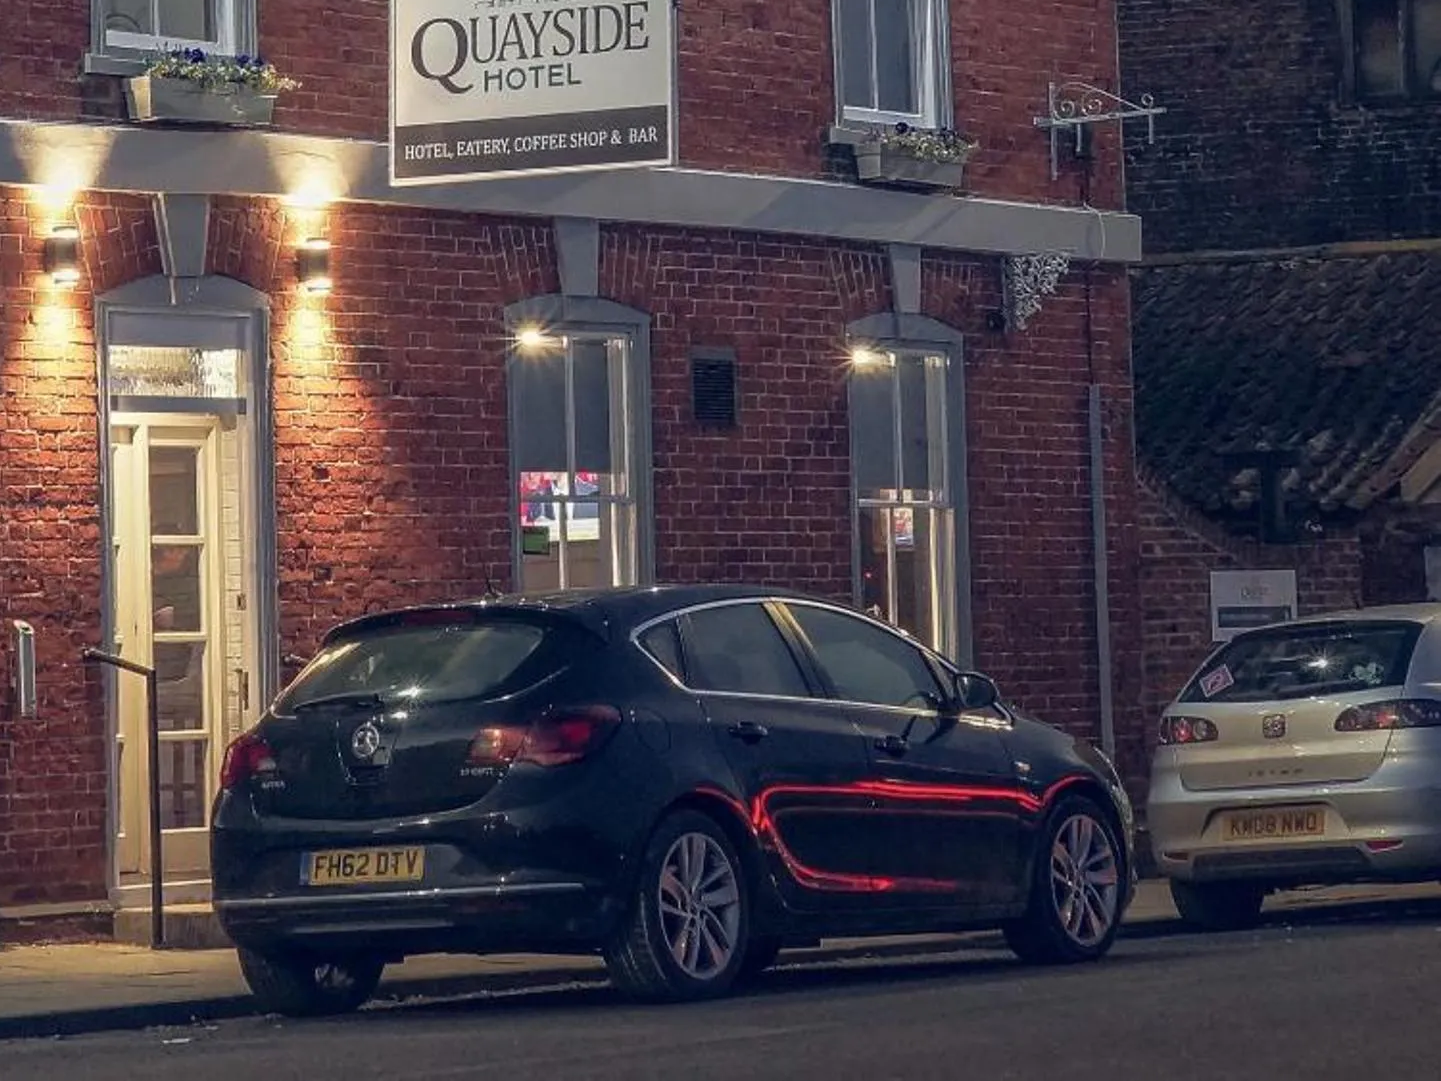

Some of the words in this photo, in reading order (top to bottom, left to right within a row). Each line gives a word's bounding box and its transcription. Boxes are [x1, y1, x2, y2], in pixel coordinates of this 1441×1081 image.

[411, 1, 650, 94] QUAYSIDE
[483, 63, 582, 93] HOTEL
[404, 143, 454, 161] HOTEL,
[456, 138, 511, 156] EATERY,
[513, 133, 568, 153] COFFEE
[570, 130, 609, 149] SHOP
[610, 129, 622, 145] &
[628, 125, 658, 144] BAR
[314, 854, 370, 880] FH62
[375, 850, 418, 876] DTV
